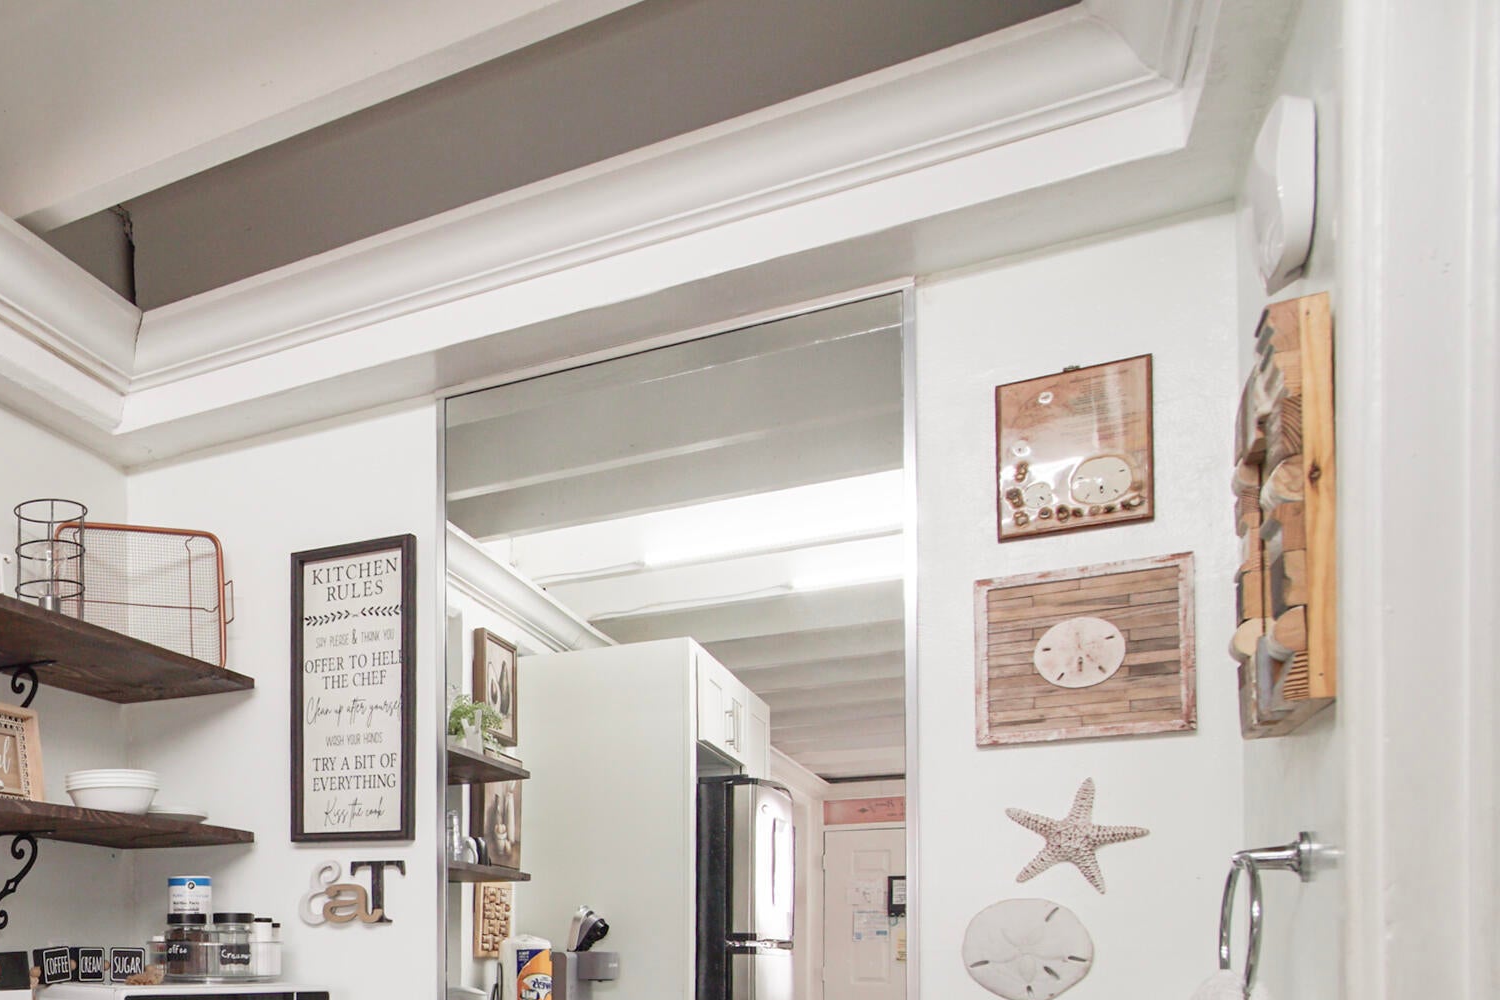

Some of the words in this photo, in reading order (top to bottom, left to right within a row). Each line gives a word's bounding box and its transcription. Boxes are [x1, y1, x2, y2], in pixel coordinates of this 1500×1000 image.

[312, 557, 398, 585] KITCHEN
[326, 579, 384, 602] RULES
[315, 636, 327, 649] SAY
[329, 632, 349, 647] PLEASE
[351, 628, 358, 645] &
[361, 630, 381, 643] THANK
[383, 627, 395, 641] YOU
[304, 656, 345, 674] OFFER
[349, 654, 368, 669] TO
[322, 673, 349, 690] THE
[352, 669, 387, 687] CHEF
[306, 696, 332, 726] Clean
[334, 704, 345, 727] up
[346, 698, 368, 726] after
[325, 733, 345, 748] WASH
[347, 732, 361, 746] YOUR
[363, 731, 383, 745] HANDS
[312, 756, 337, 772] TRY
[341, 756, 350, 770] A
[354, 754, 376, 770] BIT
[380, 752, 397, 768] OF
[312, 773, 396, 792] EVERYTHING
[324, 796, 349, 827] Kiss
[348, 797, 364, 827] the
[365, 796, 385, 819] cook
[168, 944, 188, 955] offee
[45, 955, 69, 976] COFFEE
[81, 956, 102, 973] CREAM
[114, 956, 141, 974] SUGAR
